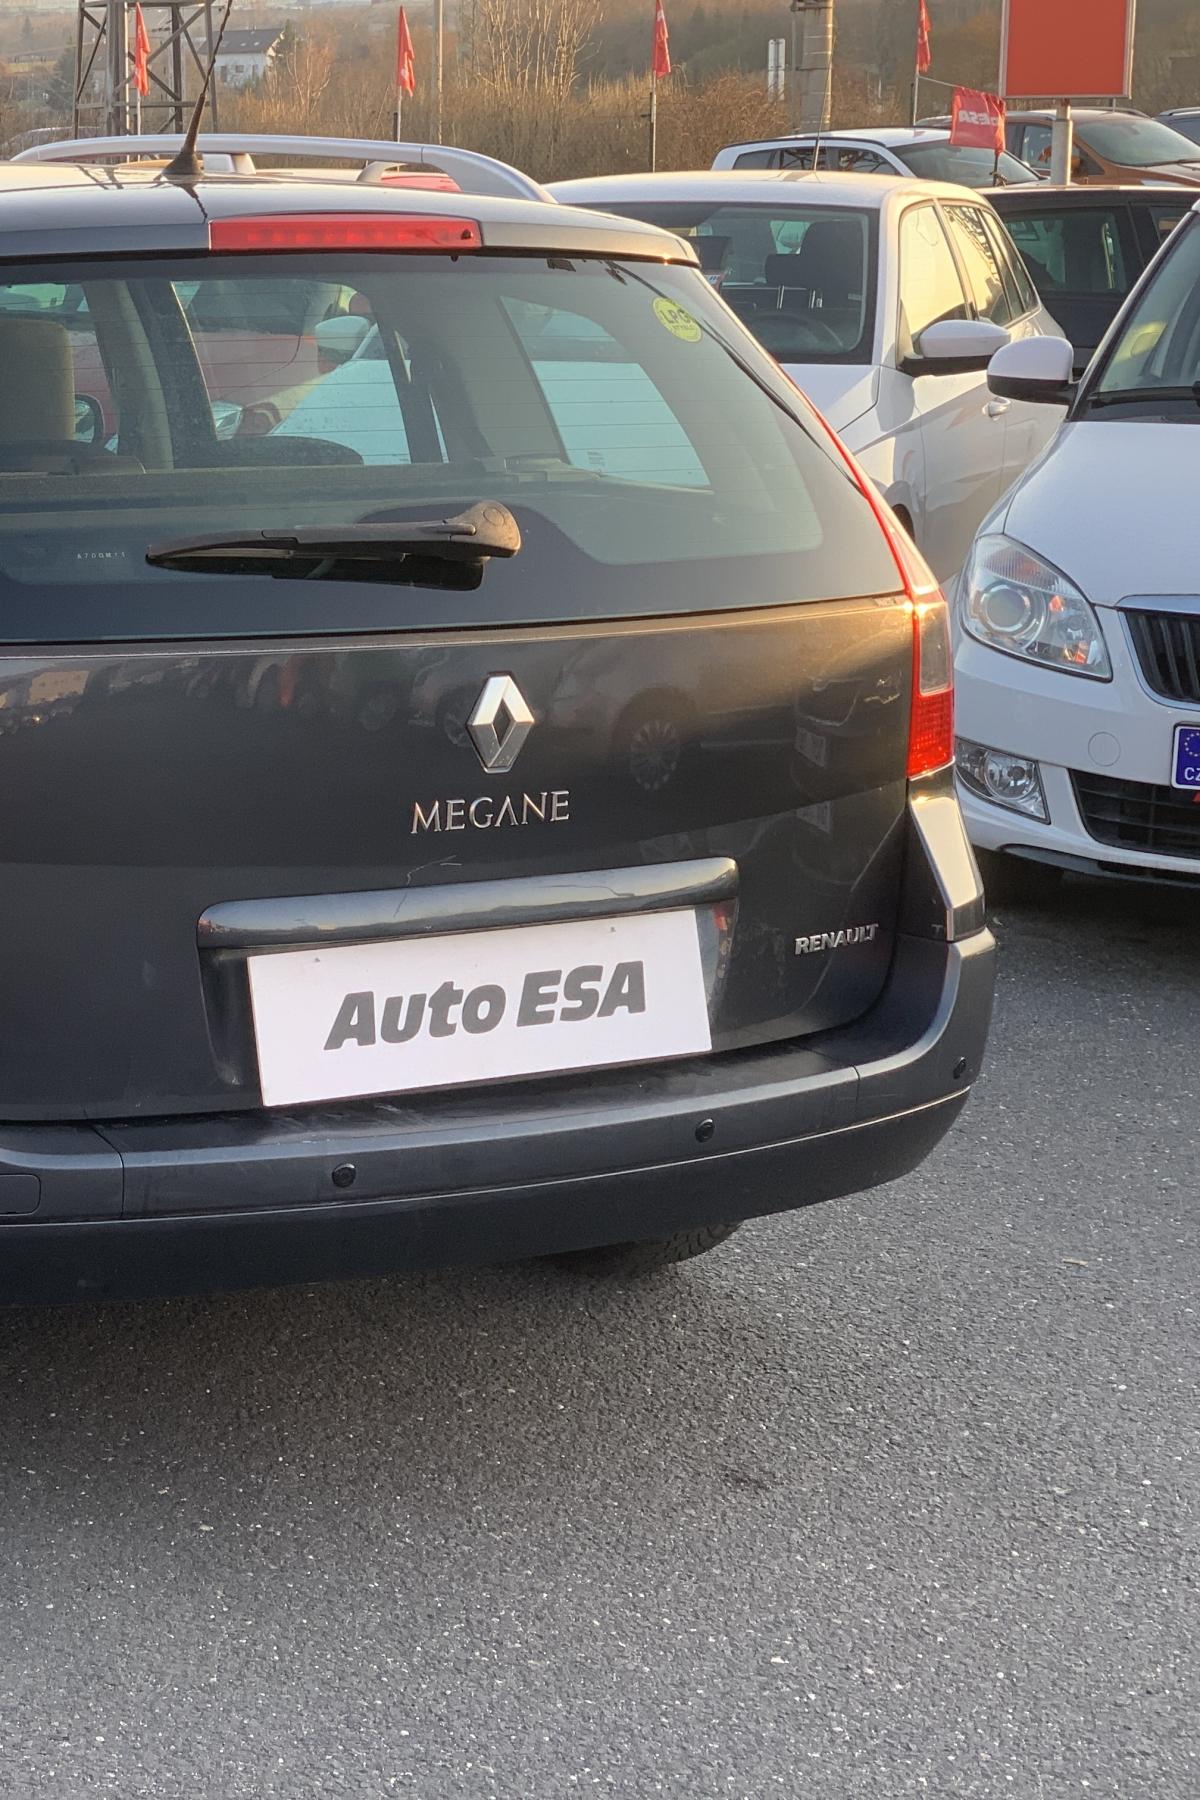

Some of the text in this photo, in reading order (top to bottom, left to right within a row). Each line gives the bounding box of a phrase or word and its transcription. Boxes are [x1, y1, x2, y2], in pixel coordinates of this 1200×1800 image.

[410, 790, 570, 835] MEGANE
[794, 923, 880, 956] RENAULT
[323, 960, 647, 1051] Auto ESA
